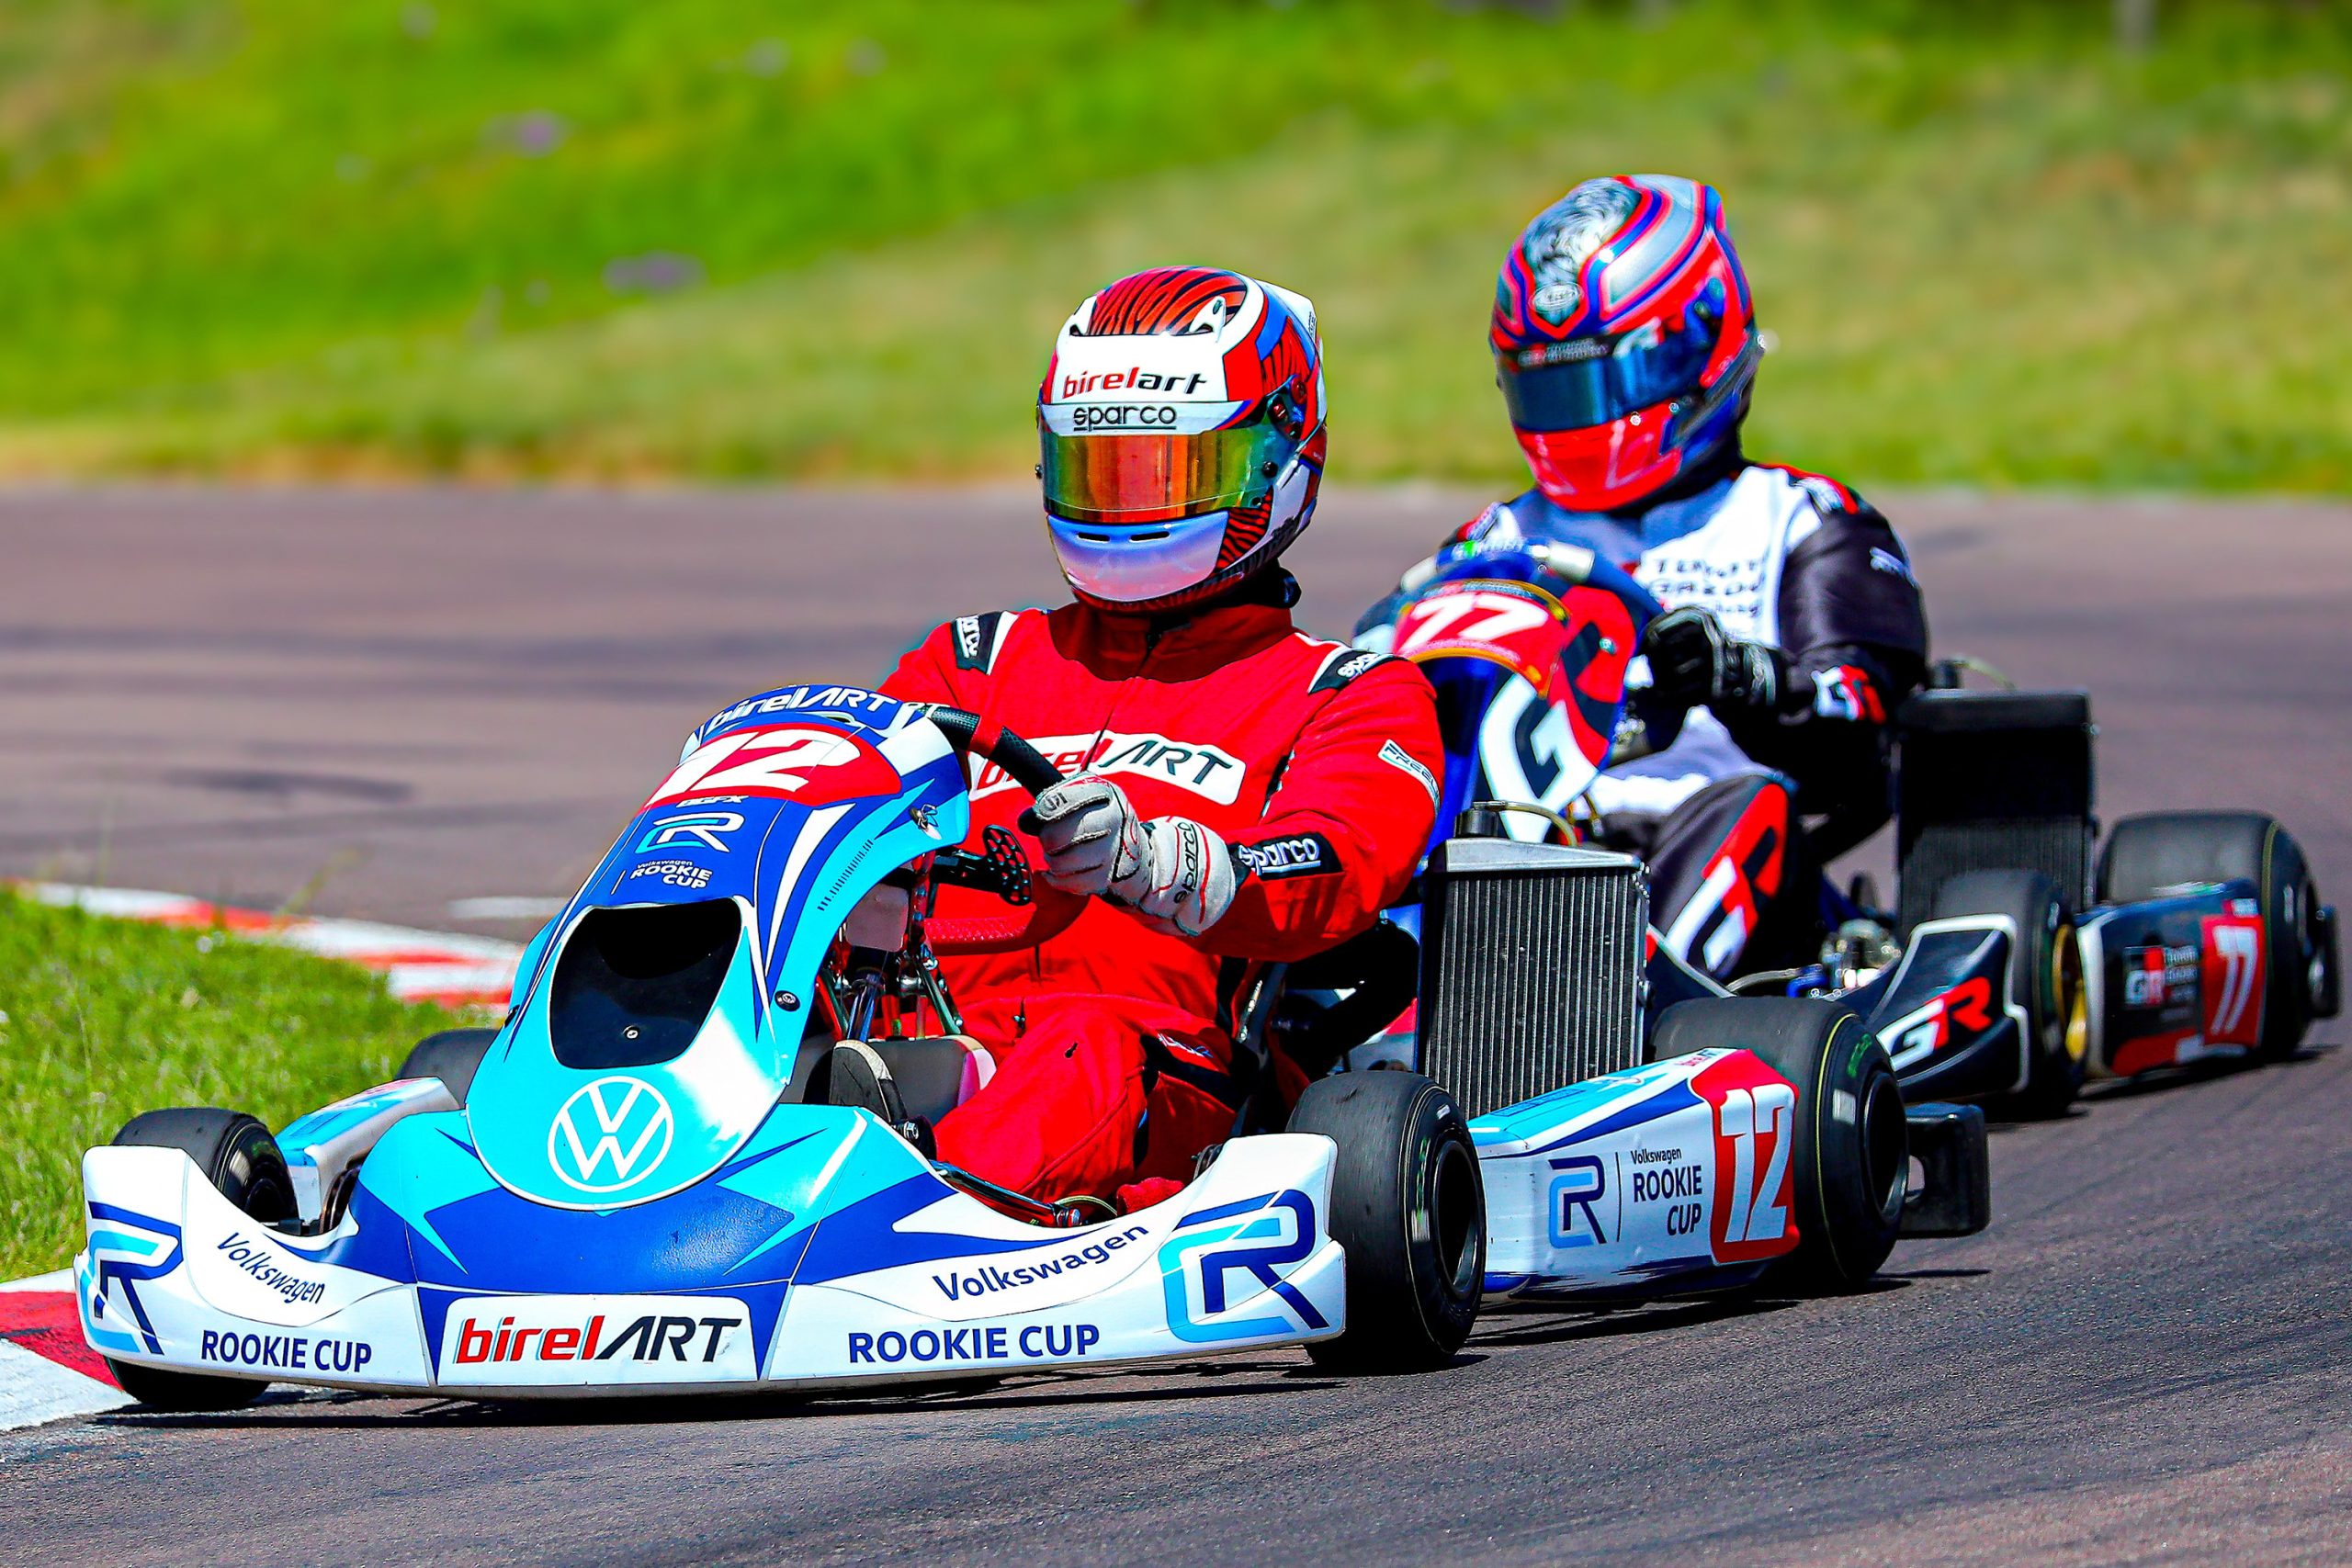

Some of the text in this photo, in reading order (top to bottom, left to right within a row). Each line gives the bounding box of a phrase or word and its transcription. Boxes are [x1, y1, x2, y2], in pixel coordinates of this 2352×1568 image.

[1073, 405, 1177, 431] sparco
[1398, 591, 1550, 654] 77
[705, 686, 898, 735] birelART
[644, 728, 861, 809] 12
[629, 864, 713, 880] ROOKIE
[1173, 821, 1199, 904] sparco
[1238, 838, 1321, 876] sparco
[662, 874, 707, 889] CUP
[1875, 976, 1992, 1072] GR
[1630, 1146, 1682, 1166] Volkswagen
[1718, 1083, 1795, 1244] 12
[1633, 1164, 1702, 1203] ROOKIE
[1667, 1201, 1702, 1236] CUP
[217, 1232, 325, 1305] Volkswagen
[933, 1221, 1149, 1303] Volkswagen
[201, 1329, 372, 1373] ROOKIE CUP
[452, 1314, 742, 1365] birelART
[848, 1323, 1101, 1364] ROOKIE CUP
